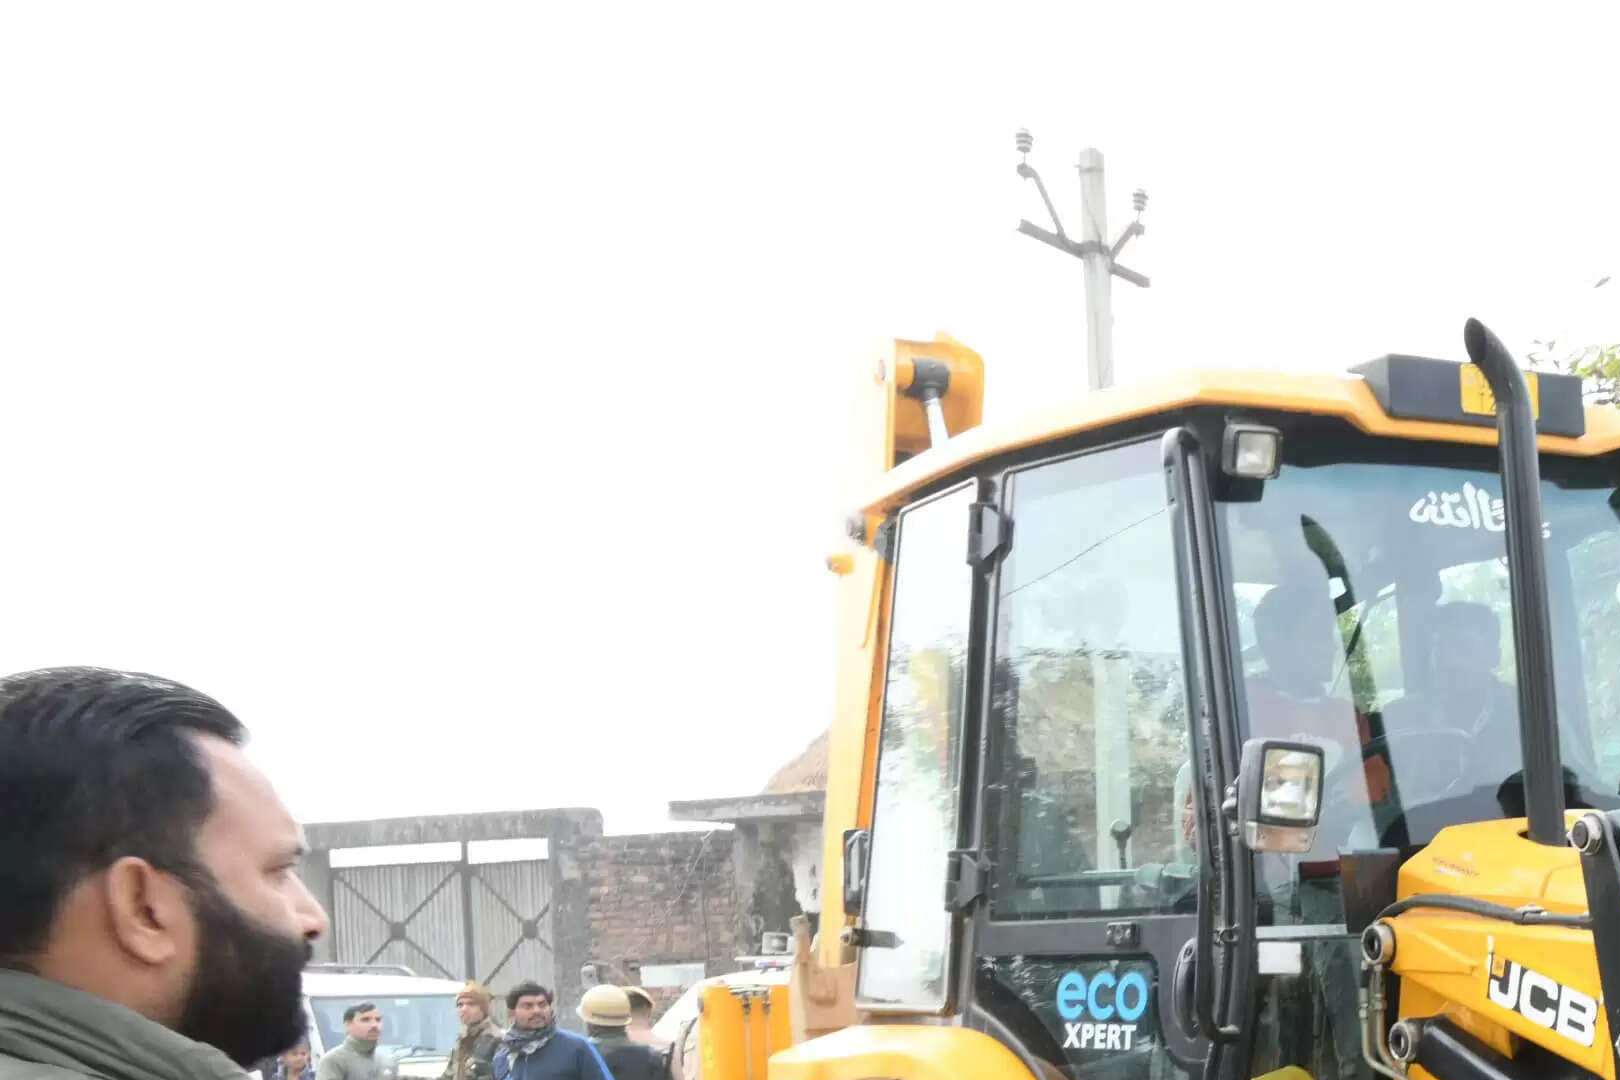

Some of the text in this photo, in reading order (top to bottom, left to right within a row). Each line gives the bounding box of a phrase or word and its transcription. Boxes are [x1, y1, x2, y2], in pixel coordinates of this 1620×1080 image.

[1056, 971, 1148, 1021] eco
[1488, 961, 1598, 1048] JCB
[1063, 1022, 1137, 1050] XPERT
